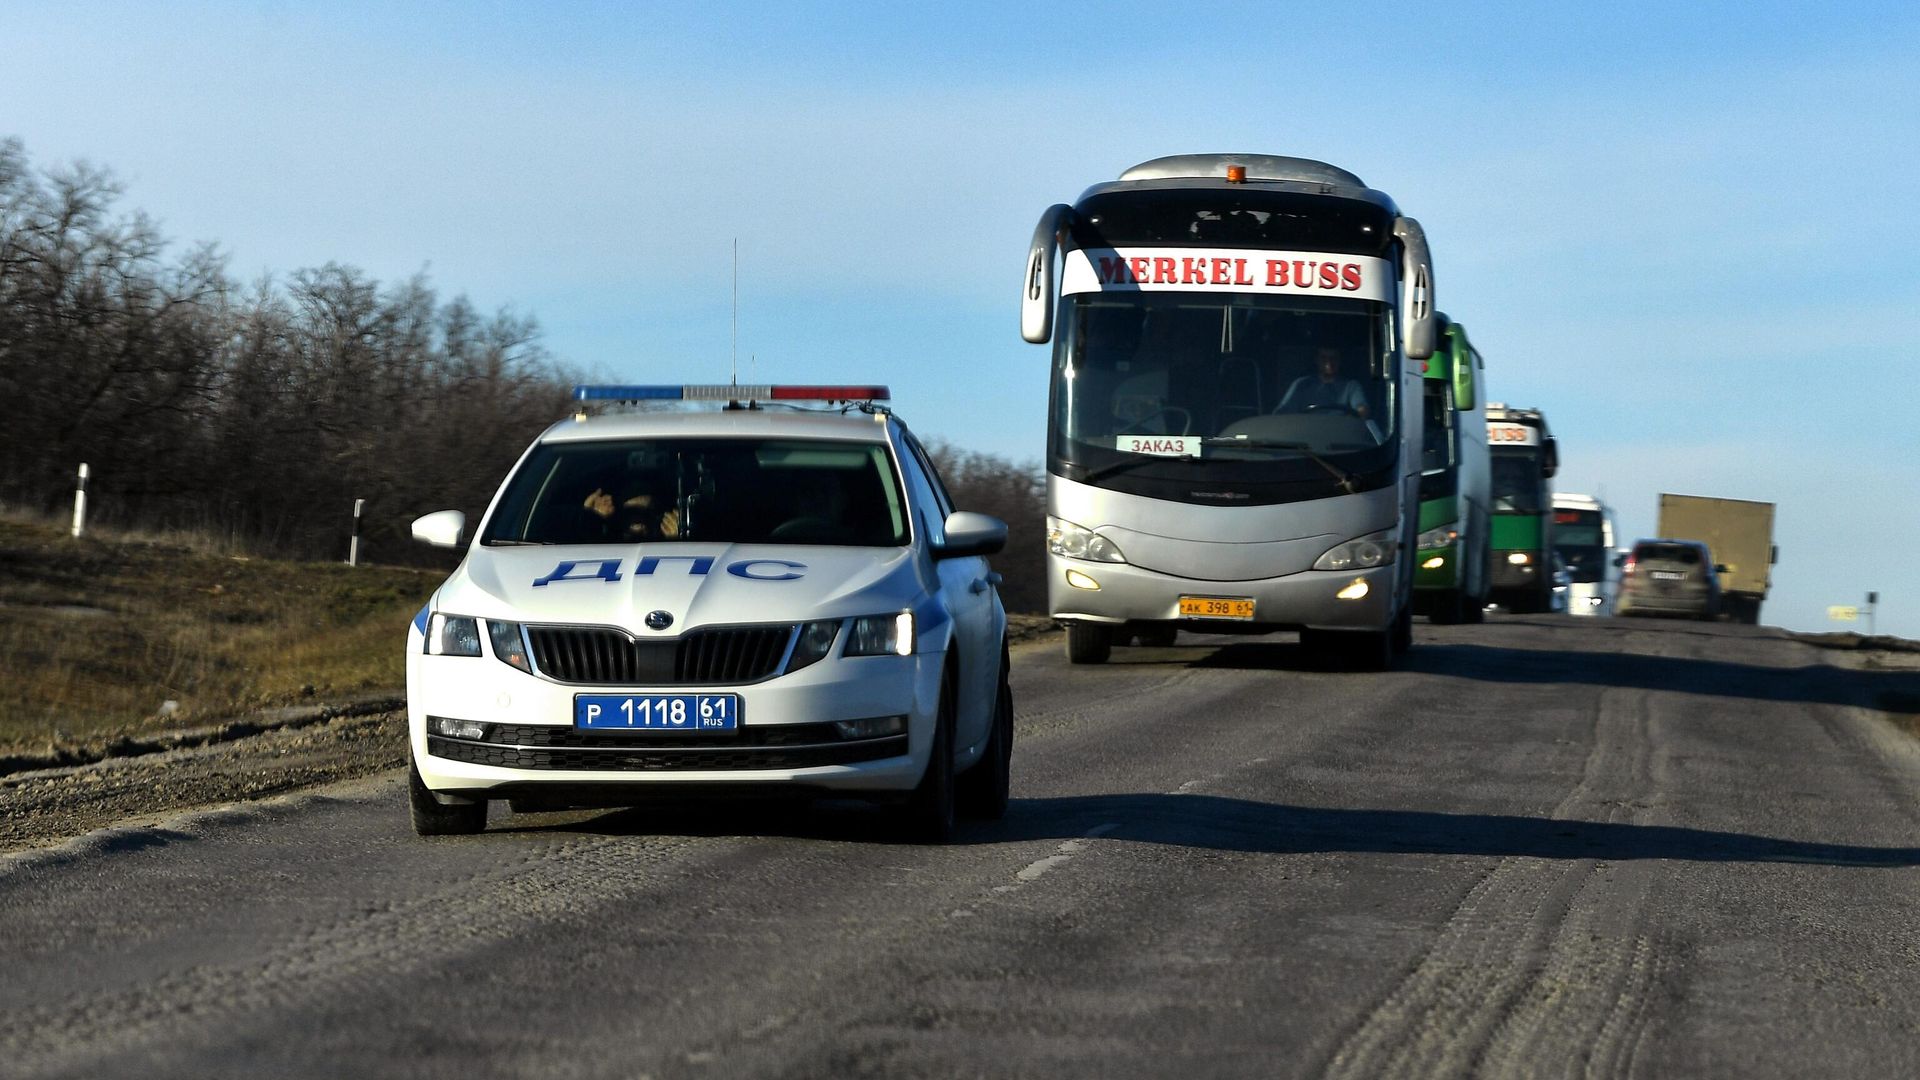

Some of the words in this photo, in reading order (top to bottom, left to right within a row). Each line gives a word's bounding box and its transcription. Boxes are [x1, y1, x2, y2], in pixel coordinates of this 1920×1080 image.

[1099, 257, 1254, 285] MERKEL
[1265, 259, 1362, 290] BUSS
[1132, 440, 1185, 452] ЗАКАЗ
[532, 556, 808, 586] ДПС
[1207, 602, 1229, 613] 398
[620, 699, 686, 725] 1118
[700, 698, 726, 718] 61
[703, 718, 723, 726] RUS
